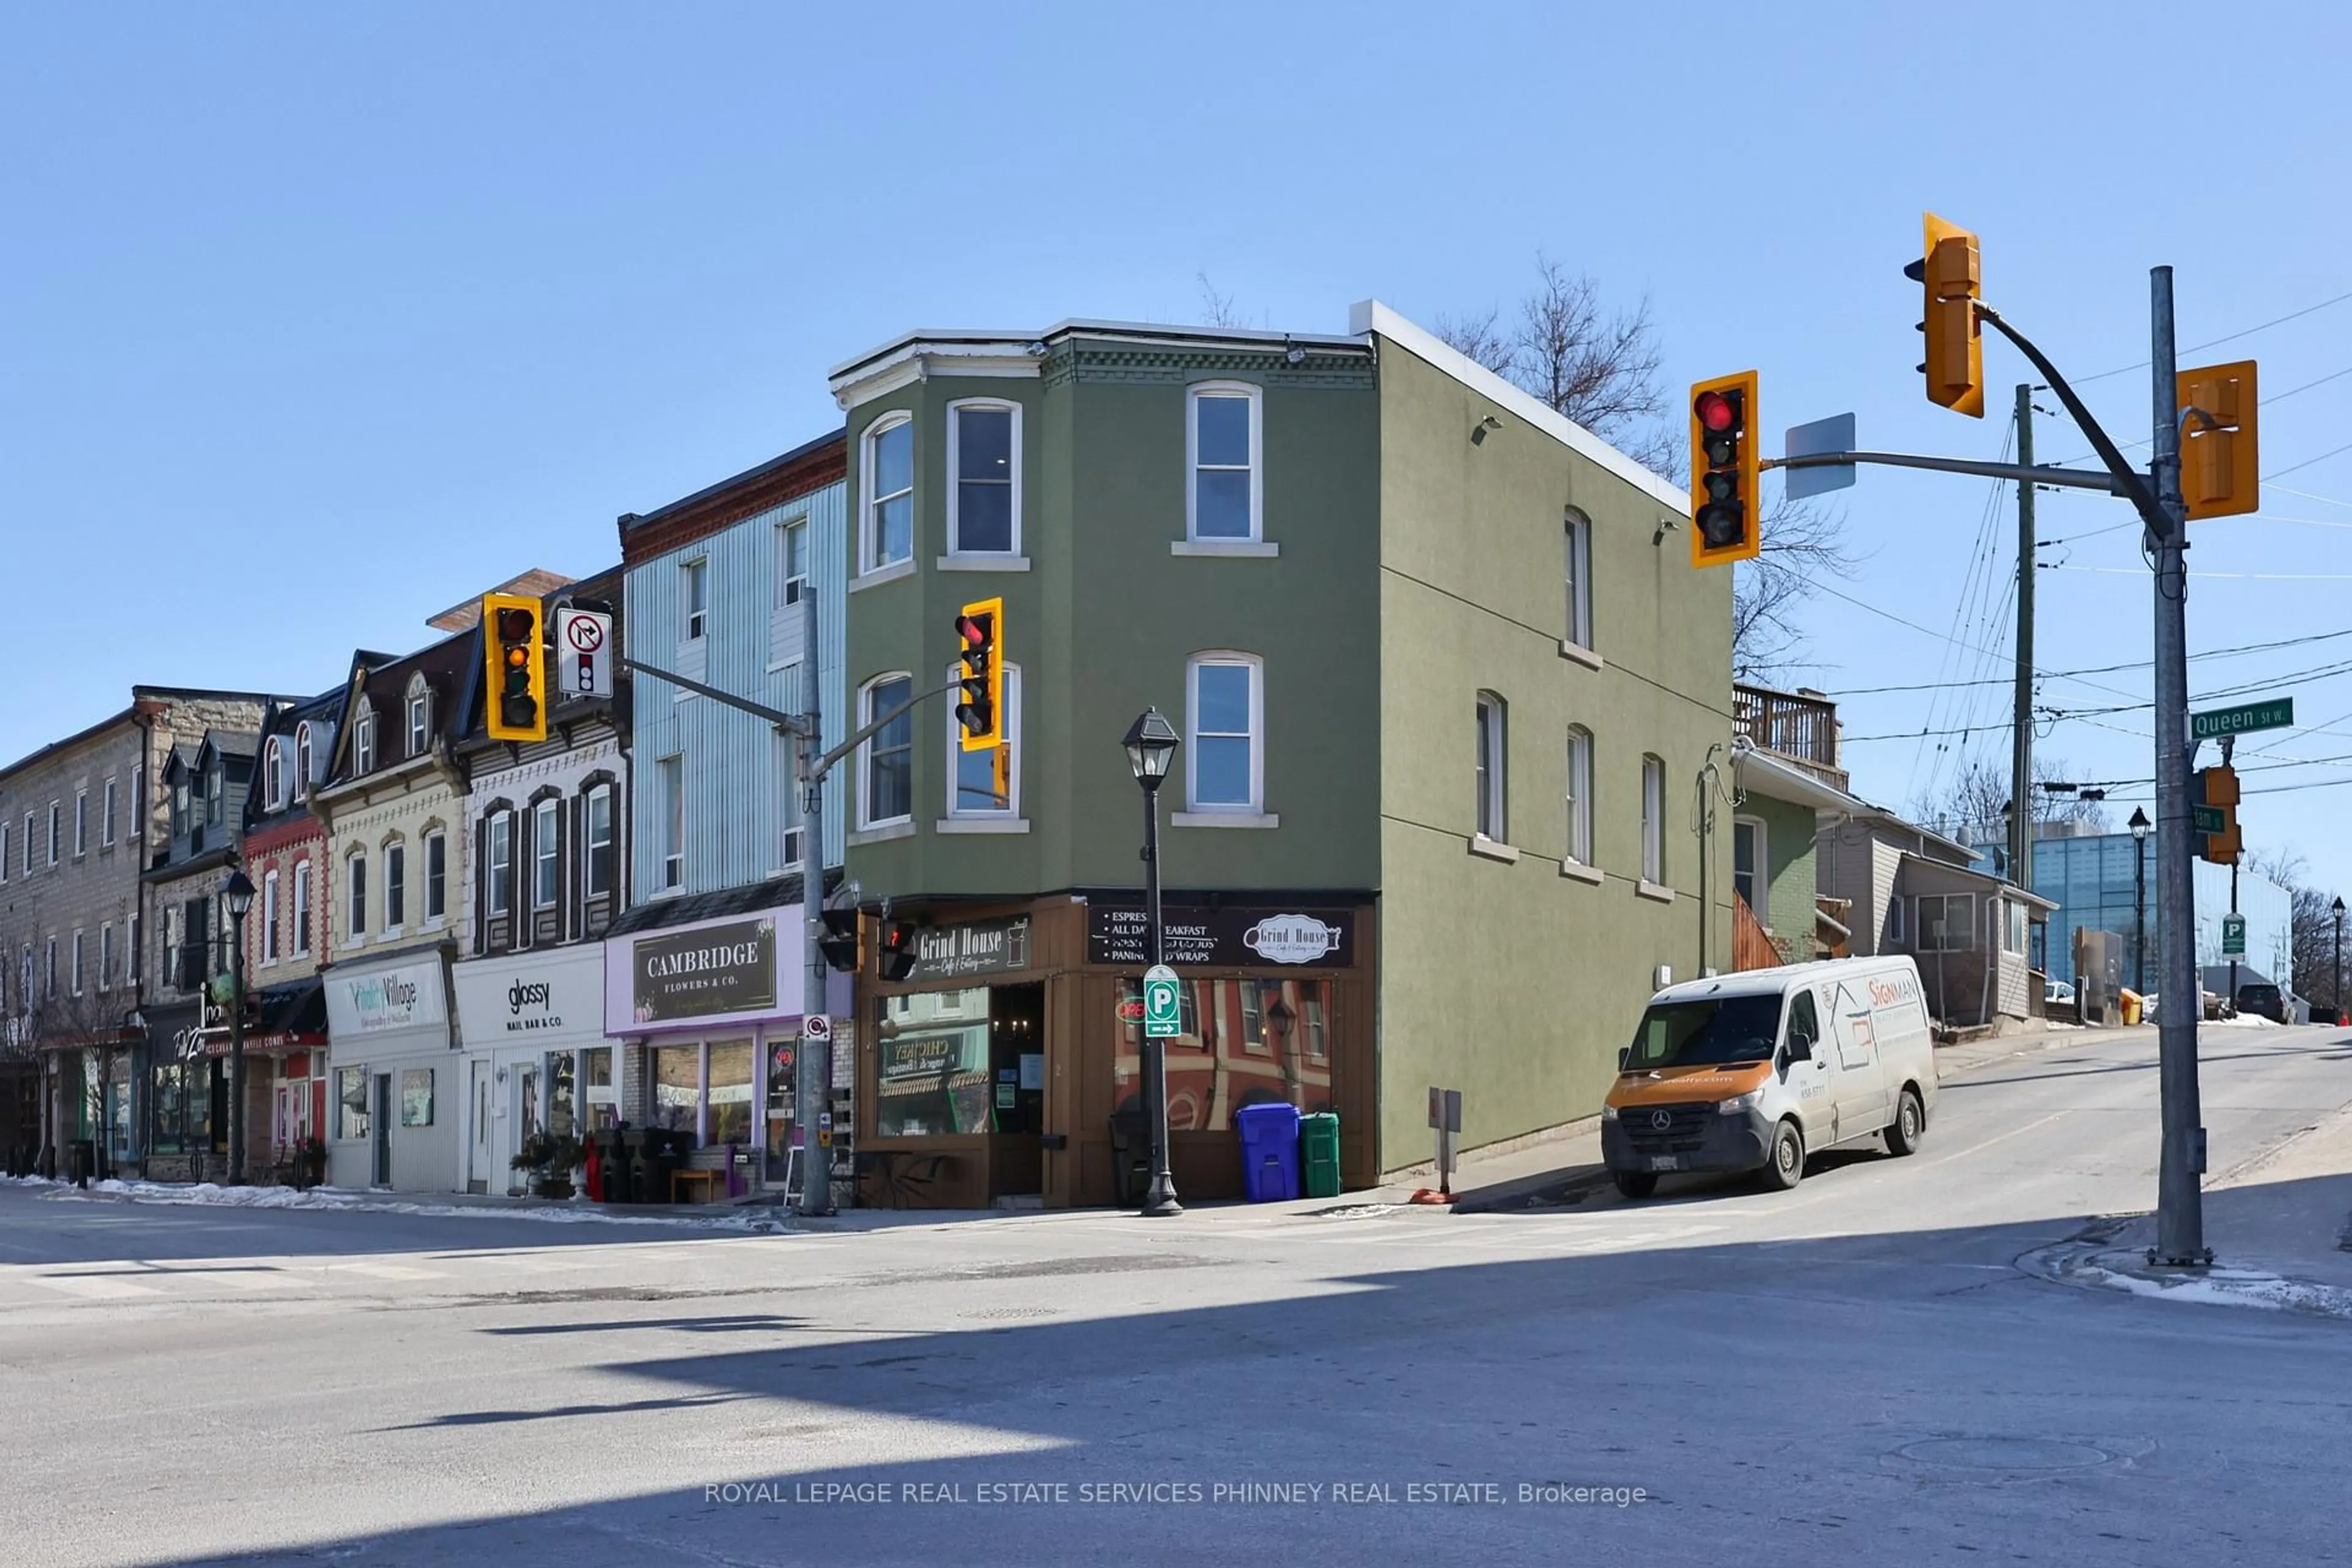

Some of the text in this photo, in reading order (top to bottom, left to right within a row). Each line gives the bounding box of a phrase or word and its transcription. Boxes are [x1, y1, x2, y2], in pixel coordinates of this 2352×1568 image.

[2196, 710, 2253, 734] Queen
[1112, 911, 1147, 921] ESPRES
[1112, 925, 1207, 936] ALL DA EAKFAST
[1261, 927, 1325, 943] Grind House
[2228, 923, 2241, 937] P
[921, 927, 1002, 960] Grind House
[647, 941, 758, 978] CAMBRIDGE
[1177, 952, 1210, 962] WRAPS
[383, 973, 417, 1012] Village
[665, 975, 739, 993] FLOWERS & CO.
[508, 978, 549, 1015] glossy
[1153, 988, 1172, 1014] P
[1118, 1002, 1145, 1017] OPE
[507, 1020, 523, 1031] NAIL
[525, 1019, 540, 1030] BAR
[542, 1018, 548, 1028] &
